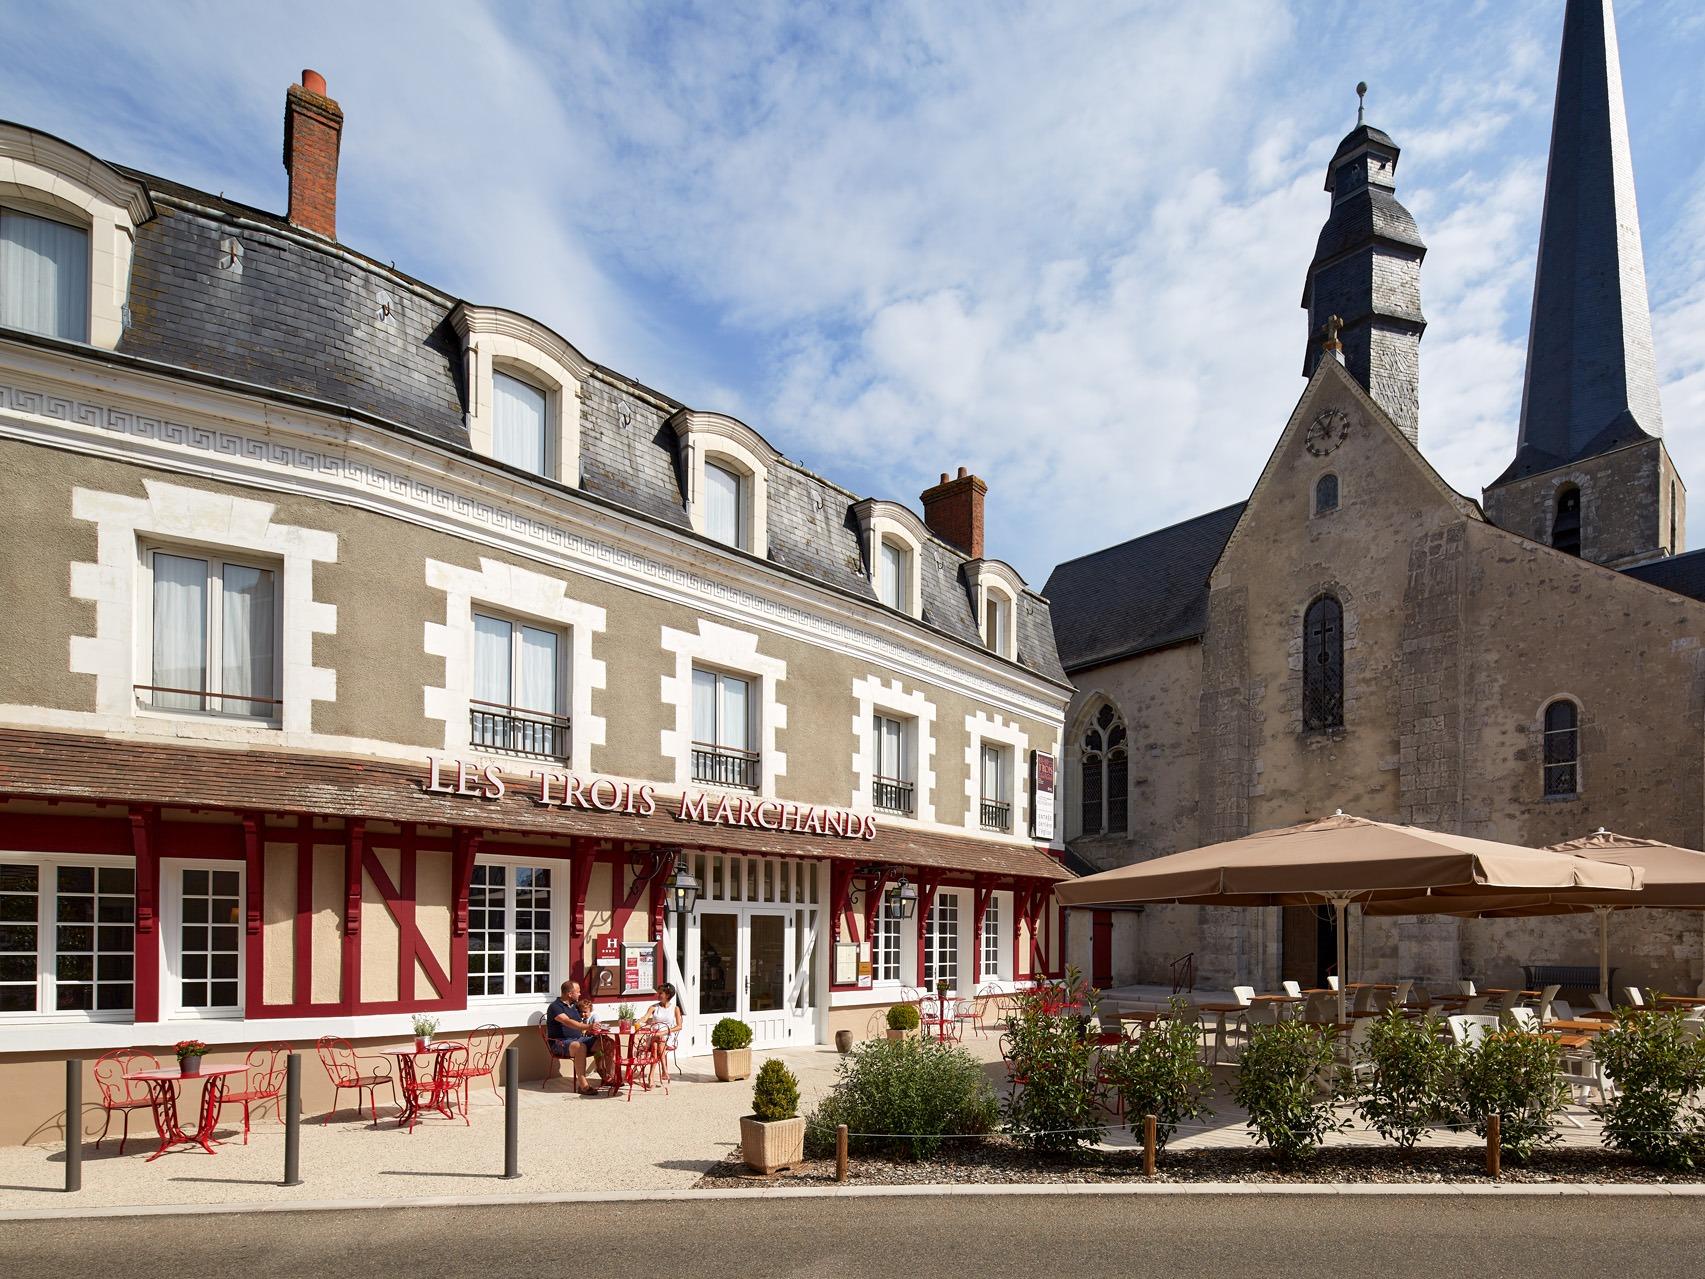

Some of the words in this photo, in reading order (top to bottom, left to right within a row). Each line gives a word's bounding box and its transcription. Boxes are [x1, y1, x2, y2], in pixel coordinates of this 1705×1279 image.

[426, 756, 505, 799] LES
[530, 770, 656, 815] TROIS
[677, 791, 877, 840] MARCHANDS
[607, 938, 618, 948] H
